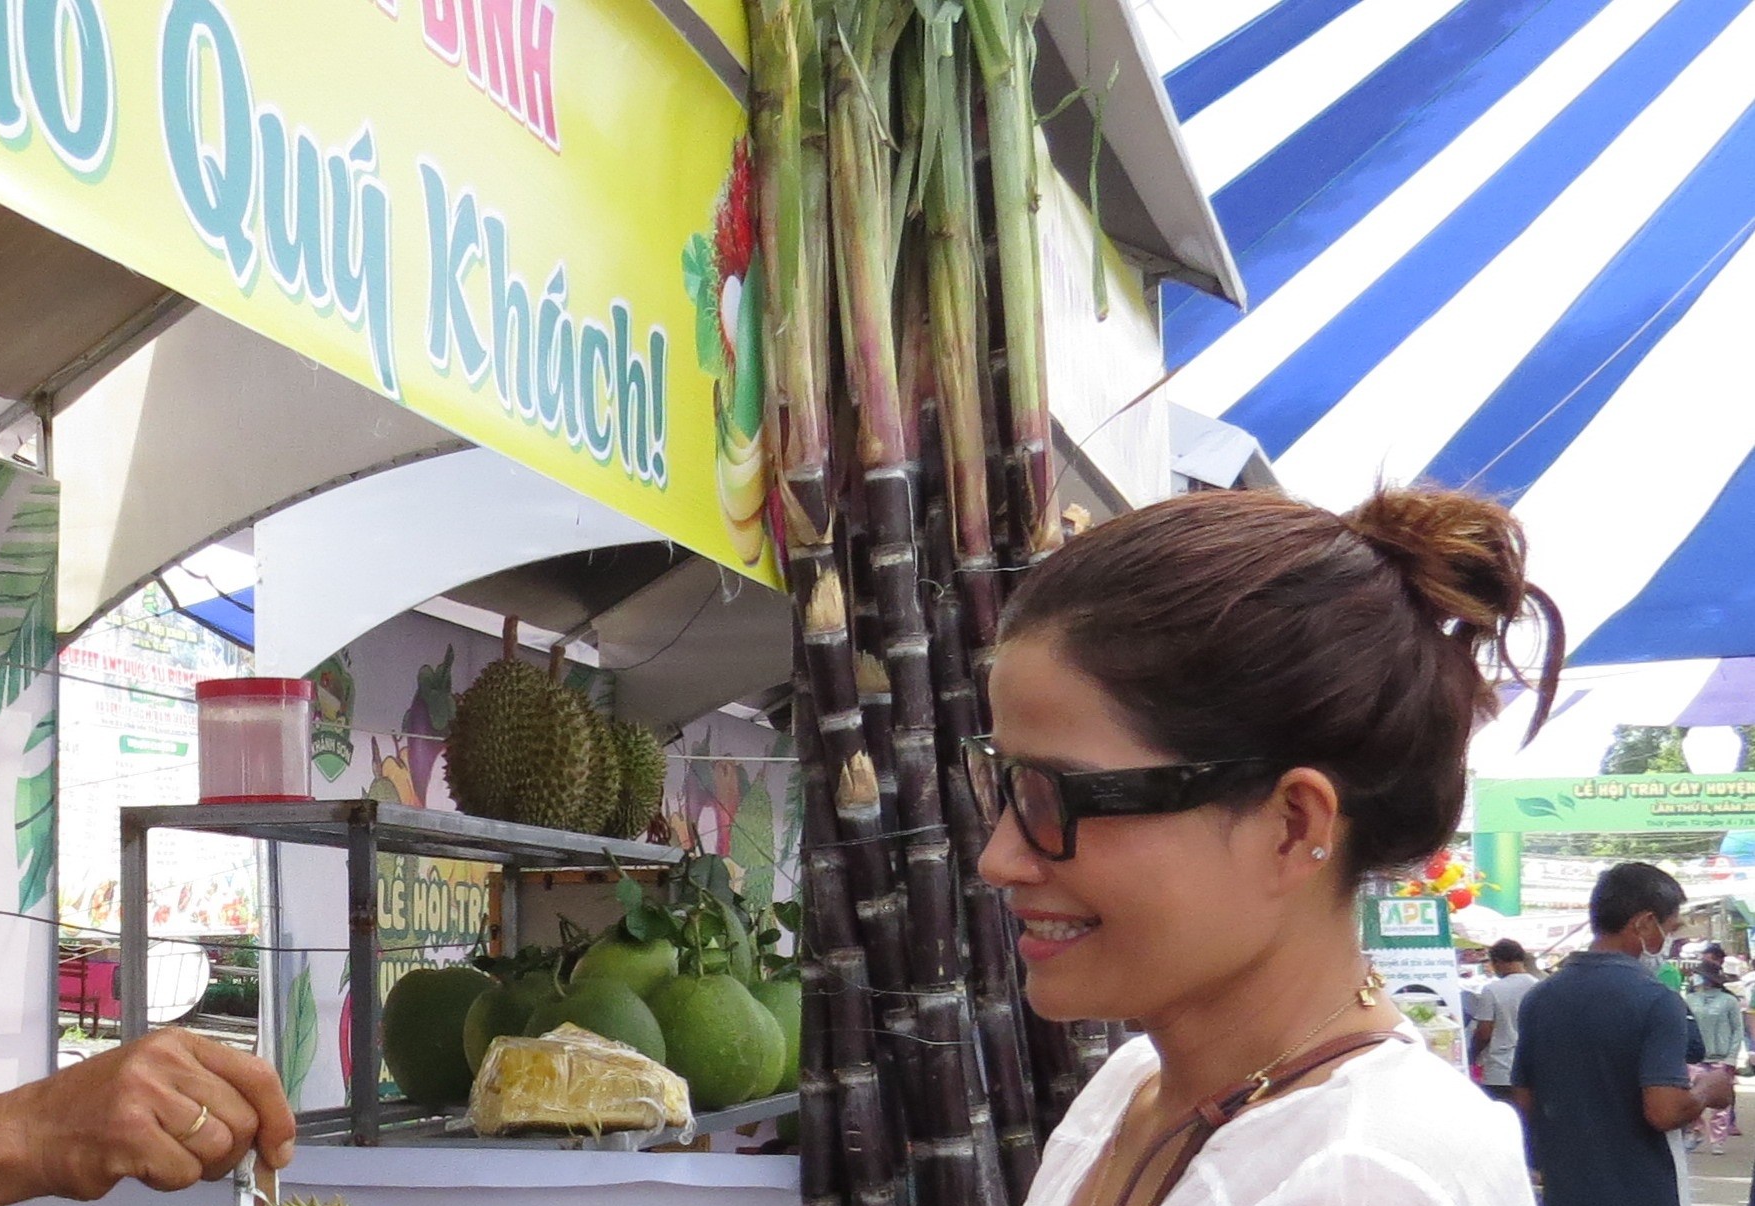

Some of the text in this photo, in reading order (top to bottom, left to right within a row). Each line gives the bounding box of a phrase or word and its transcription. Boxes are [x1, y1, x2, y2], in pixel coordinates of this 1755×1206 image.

[158, 0, 400, 400] Quý
[418, 155, 668, 488] Khách!
[377, 856, 406, 931] LỄ
[413, 869, 448, 943] HỘI
